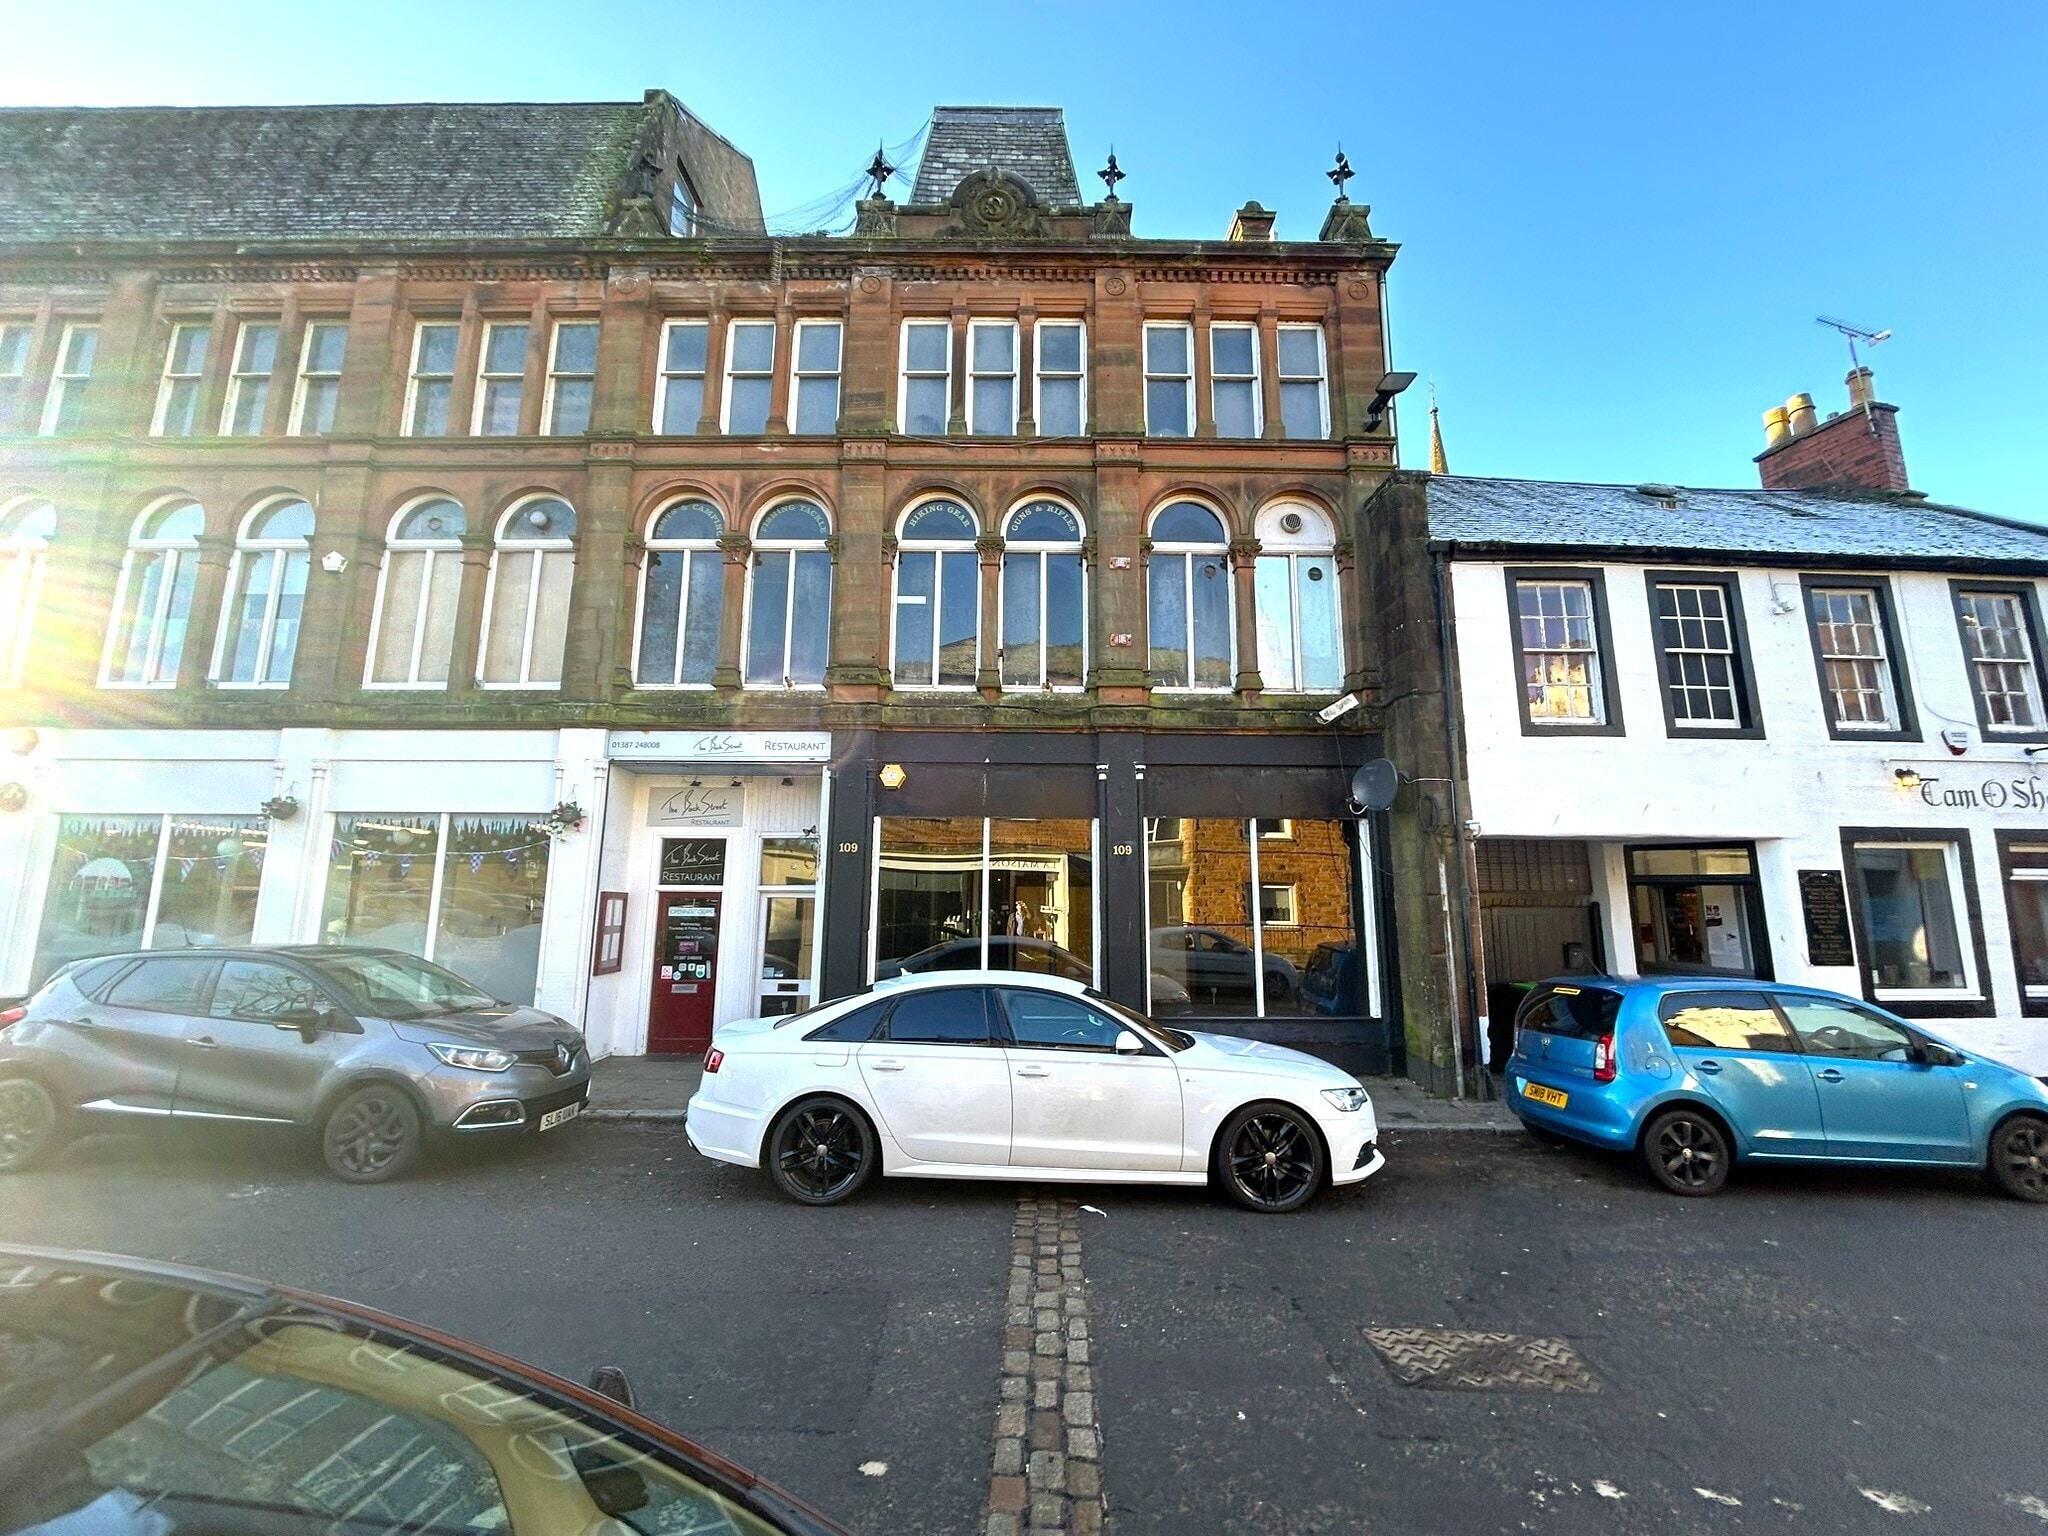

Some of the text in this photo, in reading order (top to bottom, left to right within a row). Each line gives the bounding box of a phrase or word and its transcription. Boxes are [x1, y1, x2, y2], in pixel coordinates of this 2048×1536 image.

[692, 503, 724, 538] CAMPING
[799, 504, 828, 534] TACKLE
[908, 504, 971, 528] HIKING GEAR
[1011, 505, 1077, 532] GUNS & RIFLES
[611, 741, 633, 749] 01387
[634, 741, 661, 749] 248008
[700, 789, 729, 815] Street
[2011, 776, 2048, 812] Sh
[838, 843, 858, 853] 109
[1112, 846, 1133, 855] 109
